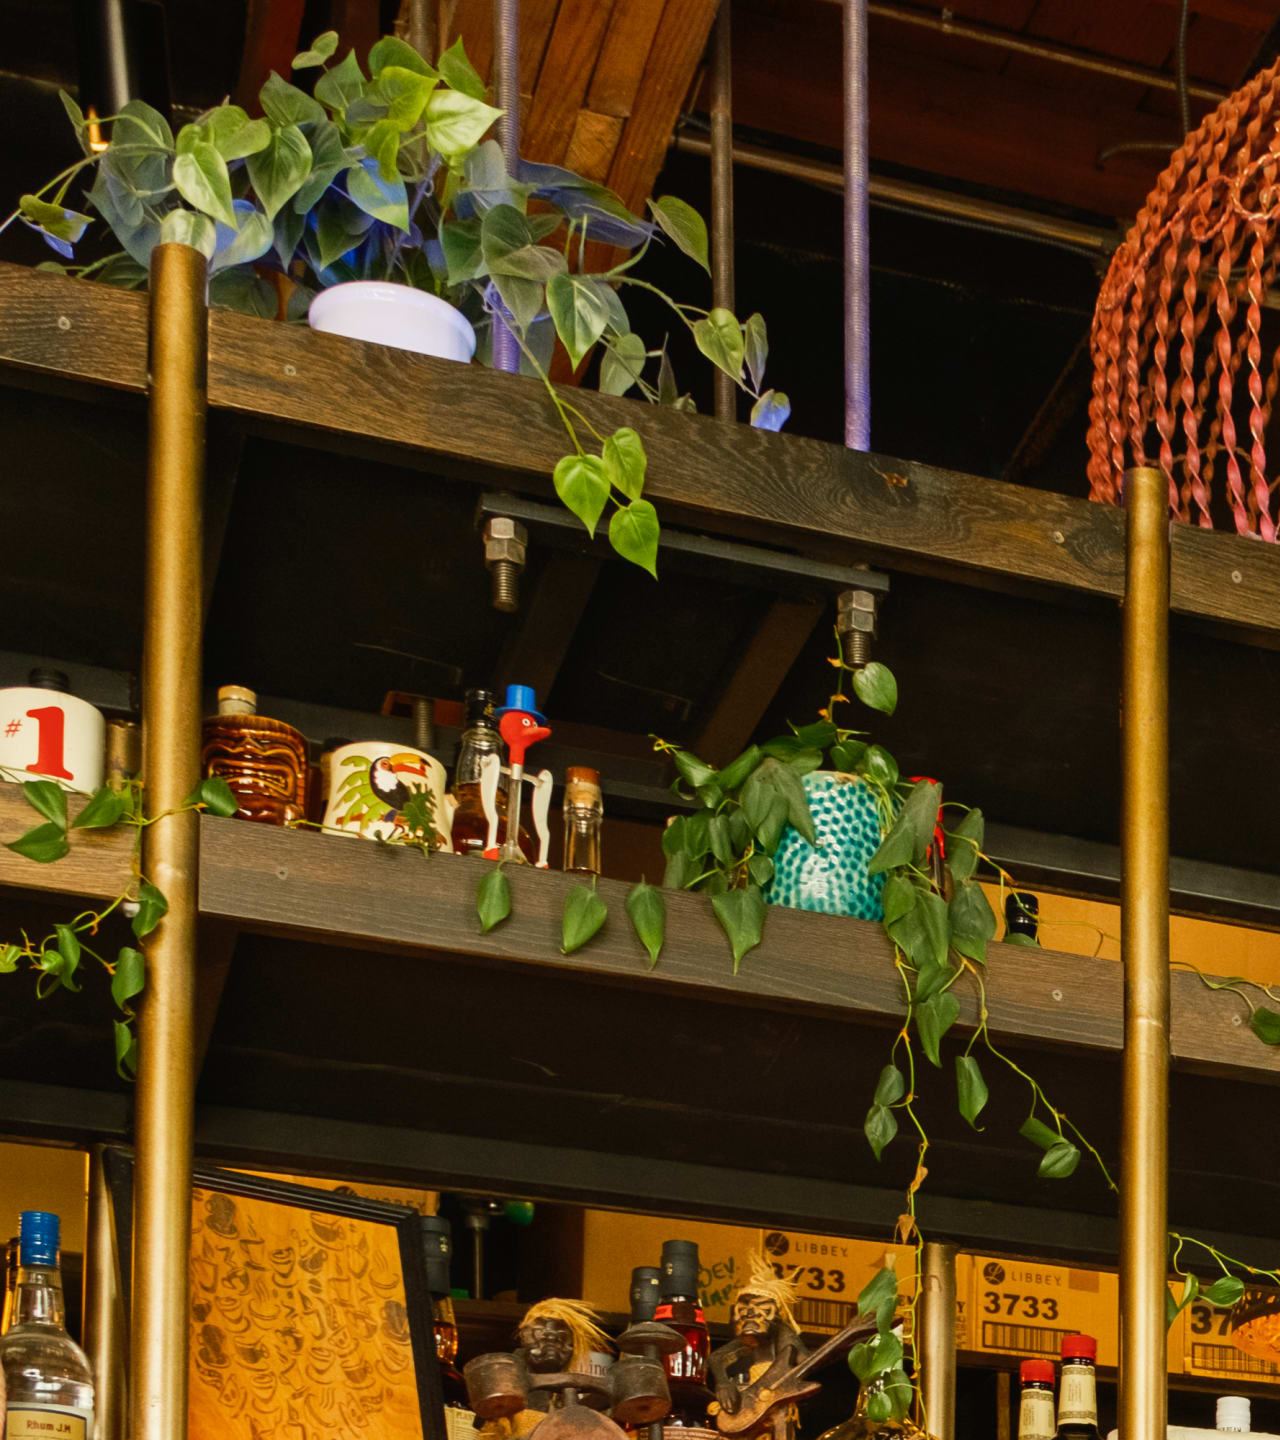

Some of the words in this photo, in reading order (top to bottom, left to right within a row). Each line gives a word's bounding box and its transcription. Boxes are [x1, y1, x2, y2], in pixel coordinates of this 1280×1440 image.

[794, 1241, 848, 1256] LIBBEY
[1010, 1271, 1062, 1286] LIBBEY
[984, 1291, 1058, 1320] 3733
[1190, 1306, 1232, 1336] 37
[26, 1419, 54, 1430] Rhum
